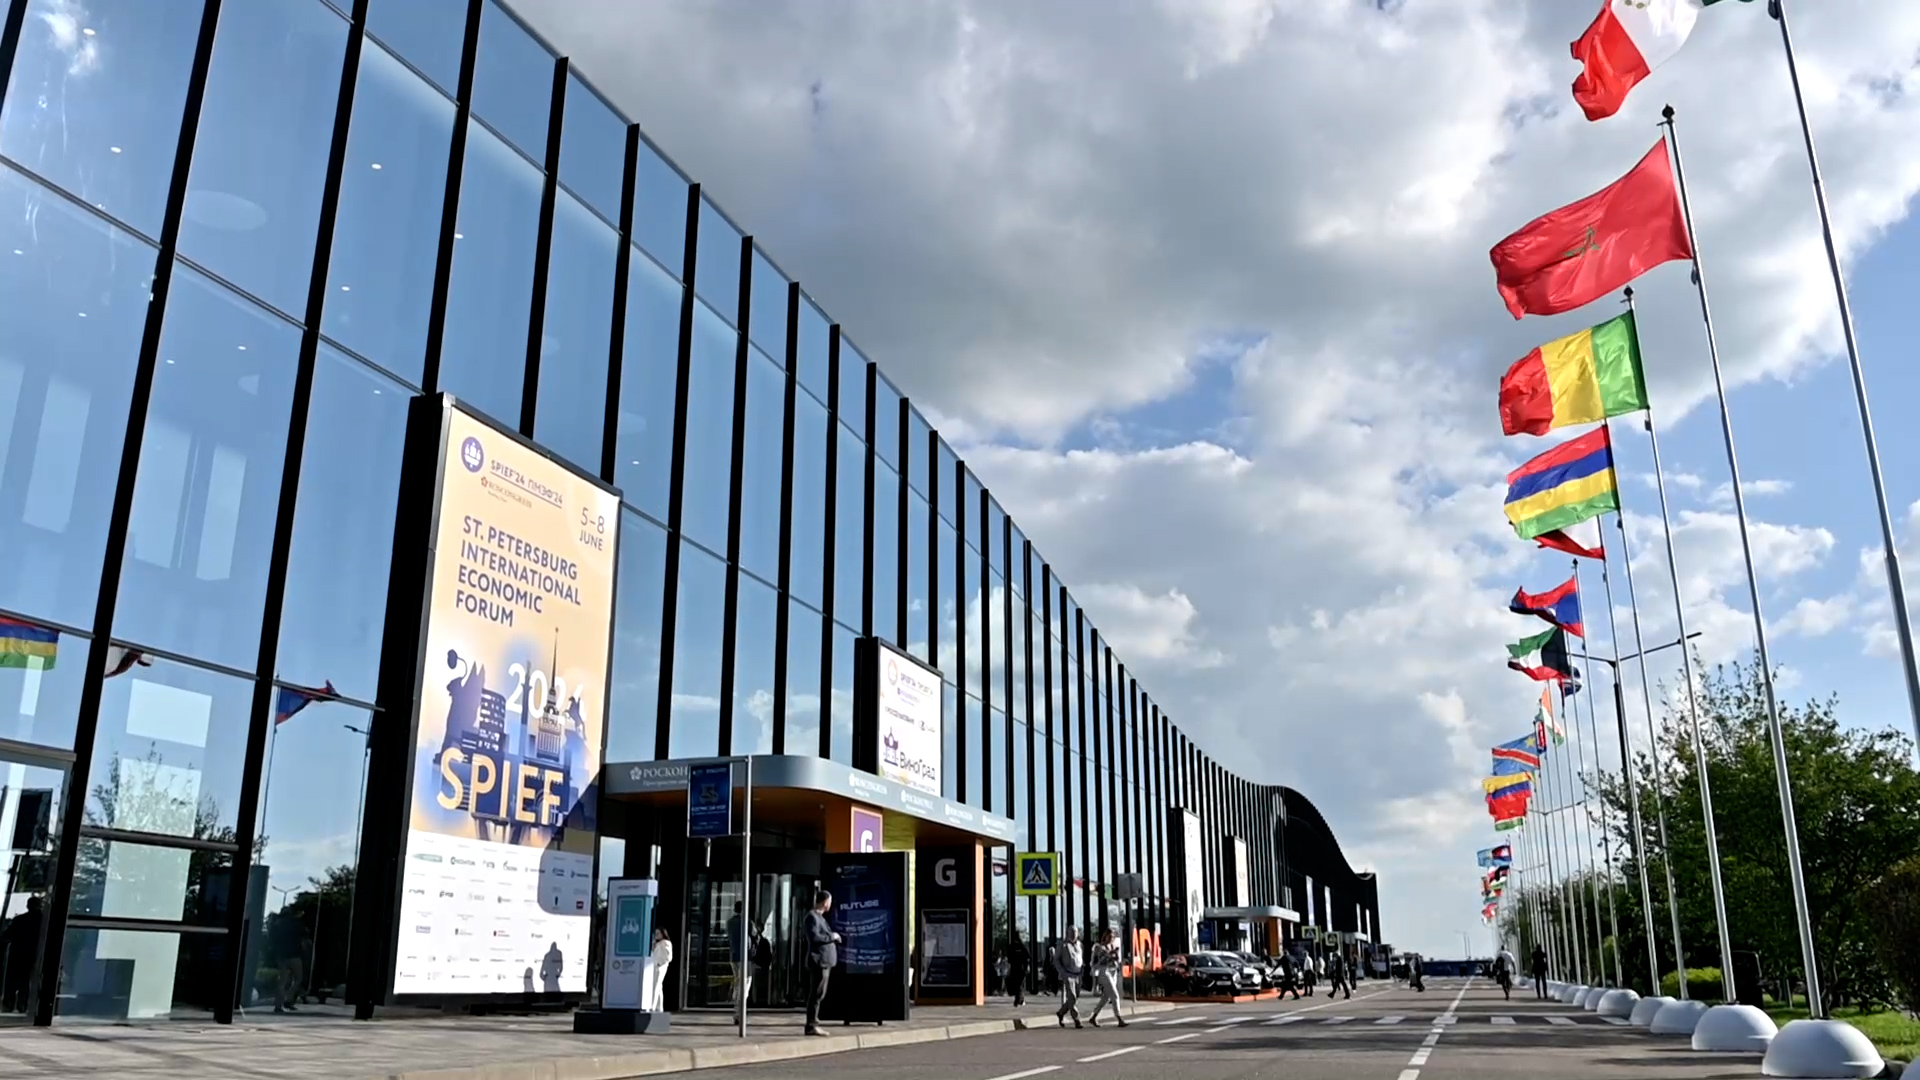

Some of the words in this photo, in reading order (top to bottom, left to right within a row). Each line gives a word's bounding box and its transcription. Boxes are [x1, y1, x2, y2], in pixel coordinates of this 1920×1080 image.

[490, 460, 525, 485] SPIEF'24
[463, 515, 484, 541] ST.
[488, 526, 578, 581] PETERSBURG
[579, 531, 603, 551] JUNE
[461, 539, 581, 606] INTERNATIONAL
[458, 565, 543, 614] ECONOMIC
[455, 590, 514, 628] FORUM
[437, 747, 563, 826] SPIEF
[643, 767, 687, 778] РОСКОН
[935, 858, 957, 887] G
[840, 899, 880, 911] RUTUBE
